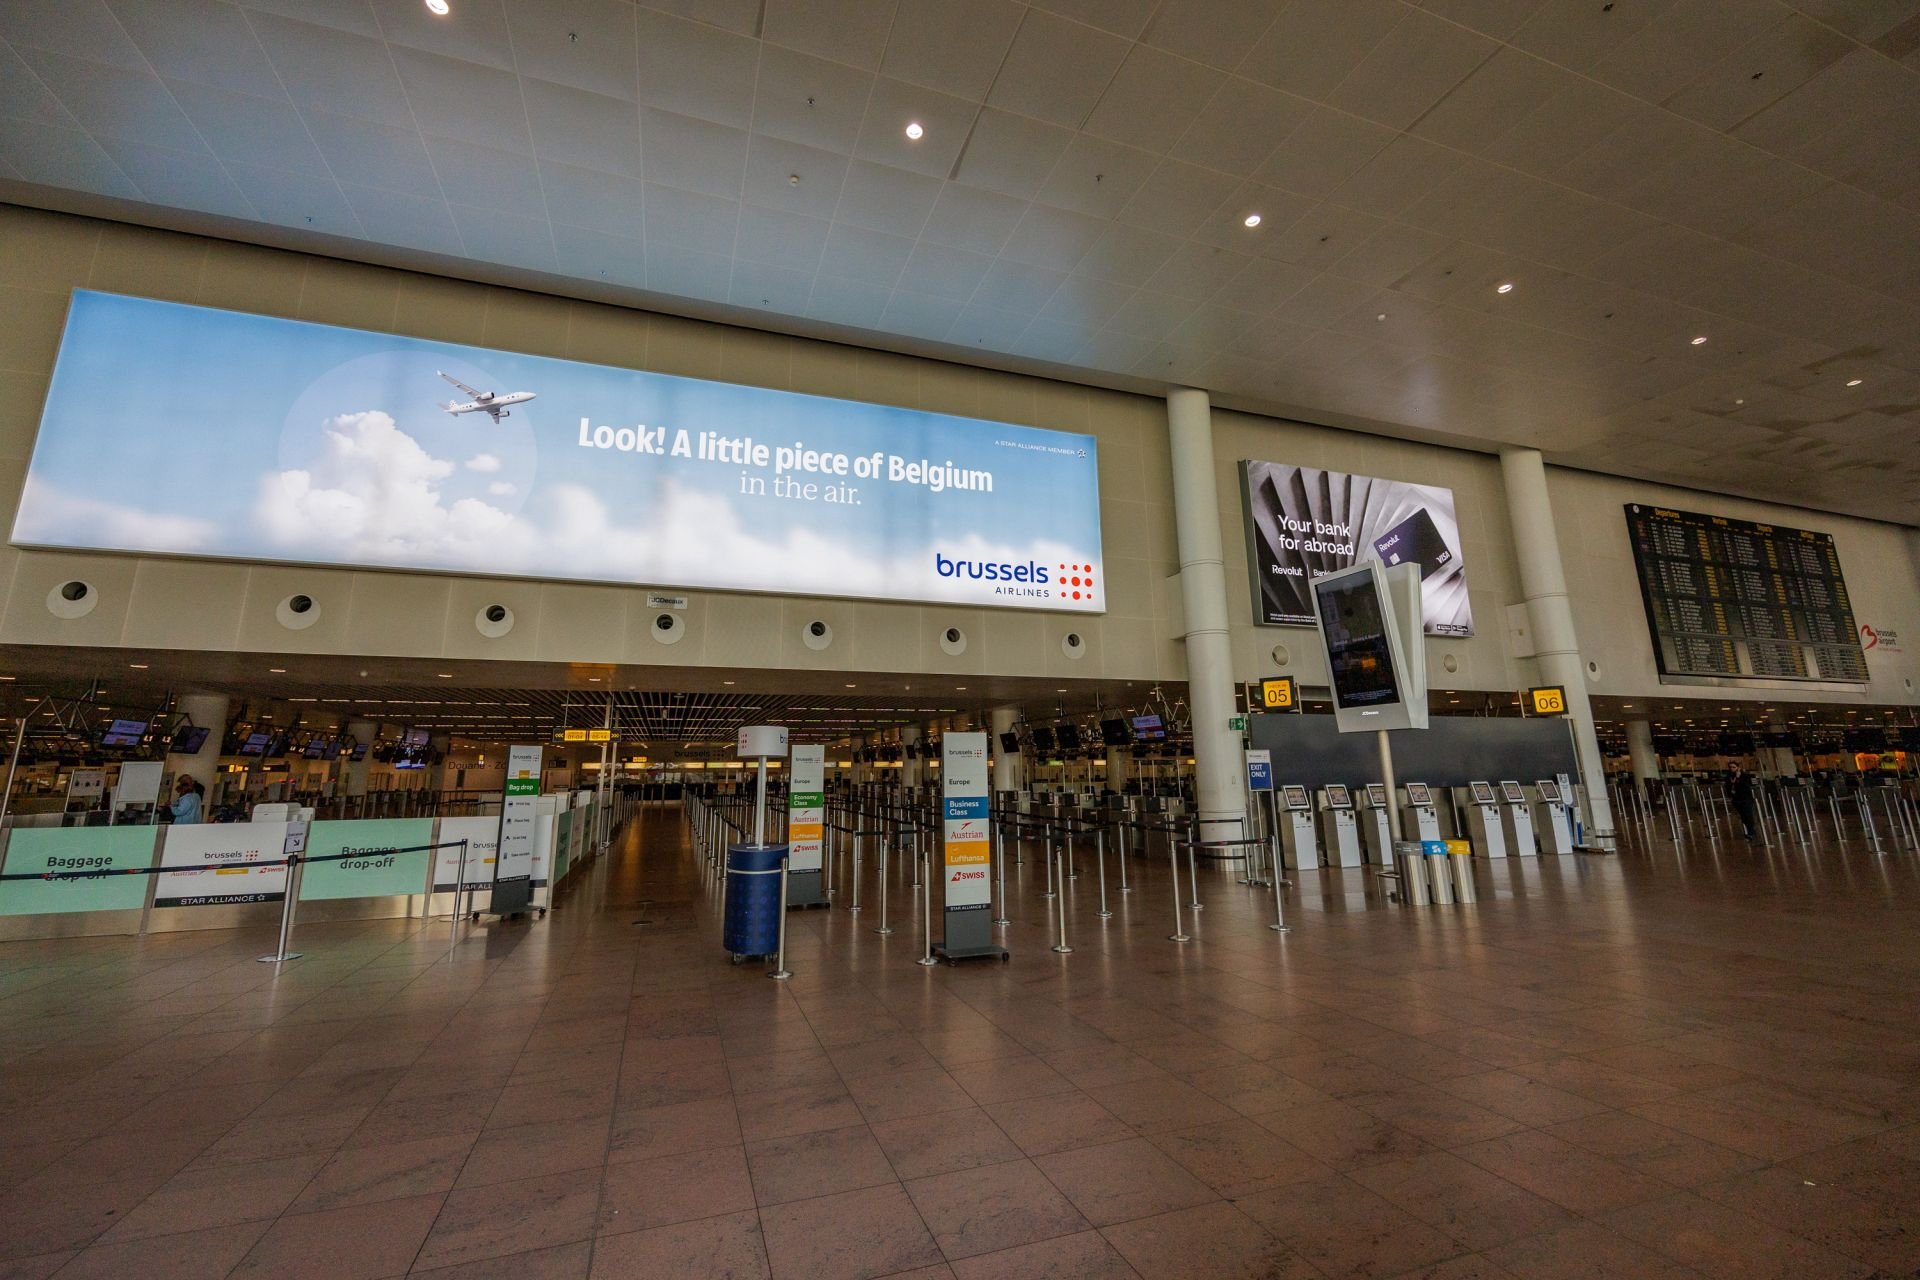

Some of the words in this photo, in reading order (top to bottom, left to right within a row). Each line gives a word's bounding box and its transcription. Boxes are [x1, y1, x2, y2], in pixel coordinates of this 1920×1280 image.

[1000, 440, 1017, 448] STAR
[1018, 443, 1048, 452] ALLIANCE
[1047, 447, 1075, 455] MEMBER
[579, 417, 666, 455] Look!
[671, 429, 692, 458] A
[698, 431, 769, 466] little
[775, 441, 849, 476] piece
[854, 452, 884, 479] of
[888, 455, 993, 492] Belgium
[739, 470, 765, 496] in
[774, 475, 818, 501] the
[823, 481, 862, 505] air.
[1278, 515, 1312, 533] Your
[1315, 519, 1351, 537] bank
[1279, 534, 1300, 550] for
[1304, 537, 1354, 556] abroad
[1378, 534, 1400, 552] Revolut
[1436, 550, 1451, 564] VISA
[936, 553, 1050, 584] brussels
[1271, 564, 1304, 577] Revolut
[995, 587, 1050, 598] AIRLINES
[1875, 628, 1898, 638] brussels
[1878, 636, 1897, 646] airport
[1268, 689, 1288, 703] 05
[1538, 697, 1560, 710] 06
[448, 761, 485, 770] Douane
[508, 784, 520, 792] Bag
[520, 784, 534, 792] drop
[948, 778, 971, 786] Europe
[949, 800, 980, 808] Business
[949, 808, 968, 816] Class
[950, 831, 984, 840] Austrian
[204, 851, 243, 859] brussels
[950, 855, 985, 863] Lufthansa
[47, 856, 113, 869] Baggage
[340, 857, 396, 871] drop-off
[961, 871, 985, 879] SWISS
[180, 897, 206, 905] STAR
[207, 895, 255, 904] ALLIANCE
